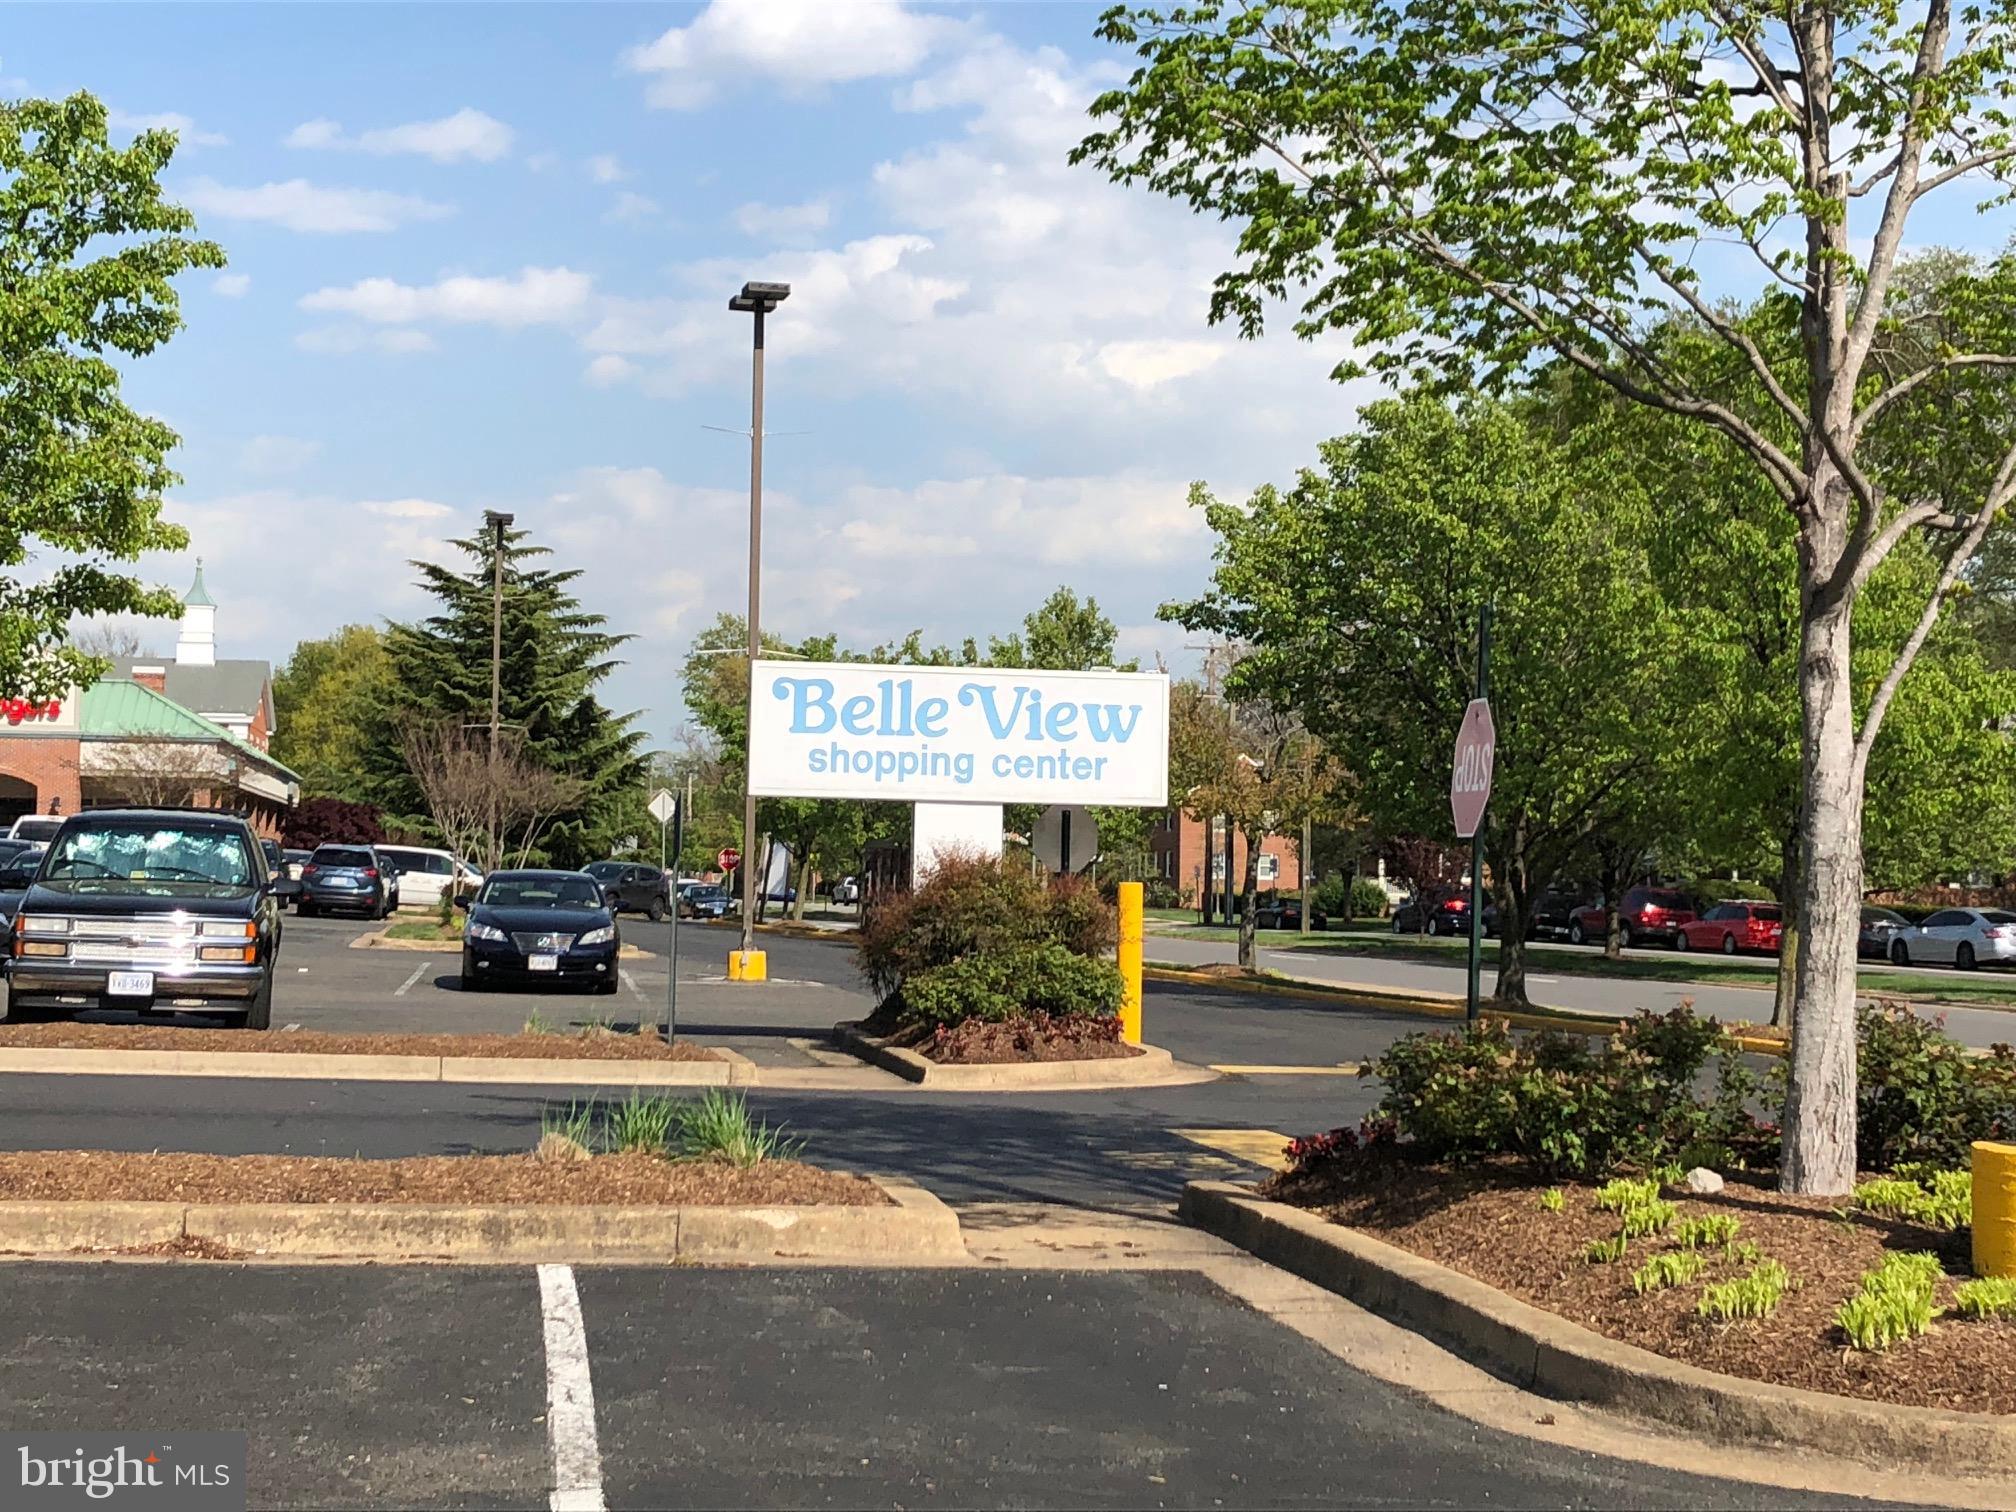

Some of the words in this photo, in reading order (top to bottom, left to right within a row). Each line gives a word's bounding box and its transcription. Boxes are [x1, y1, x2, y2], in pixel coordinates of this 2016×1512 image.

[773, 677, 949, 738] Belle
[957, 682, 1142, 742] View
[808, 742, 975, 784] shopping
[991, 748, 1108, 780] center
[1454, 742, 1491, 793] STOP
[720, 854, 740, 864] STOP
